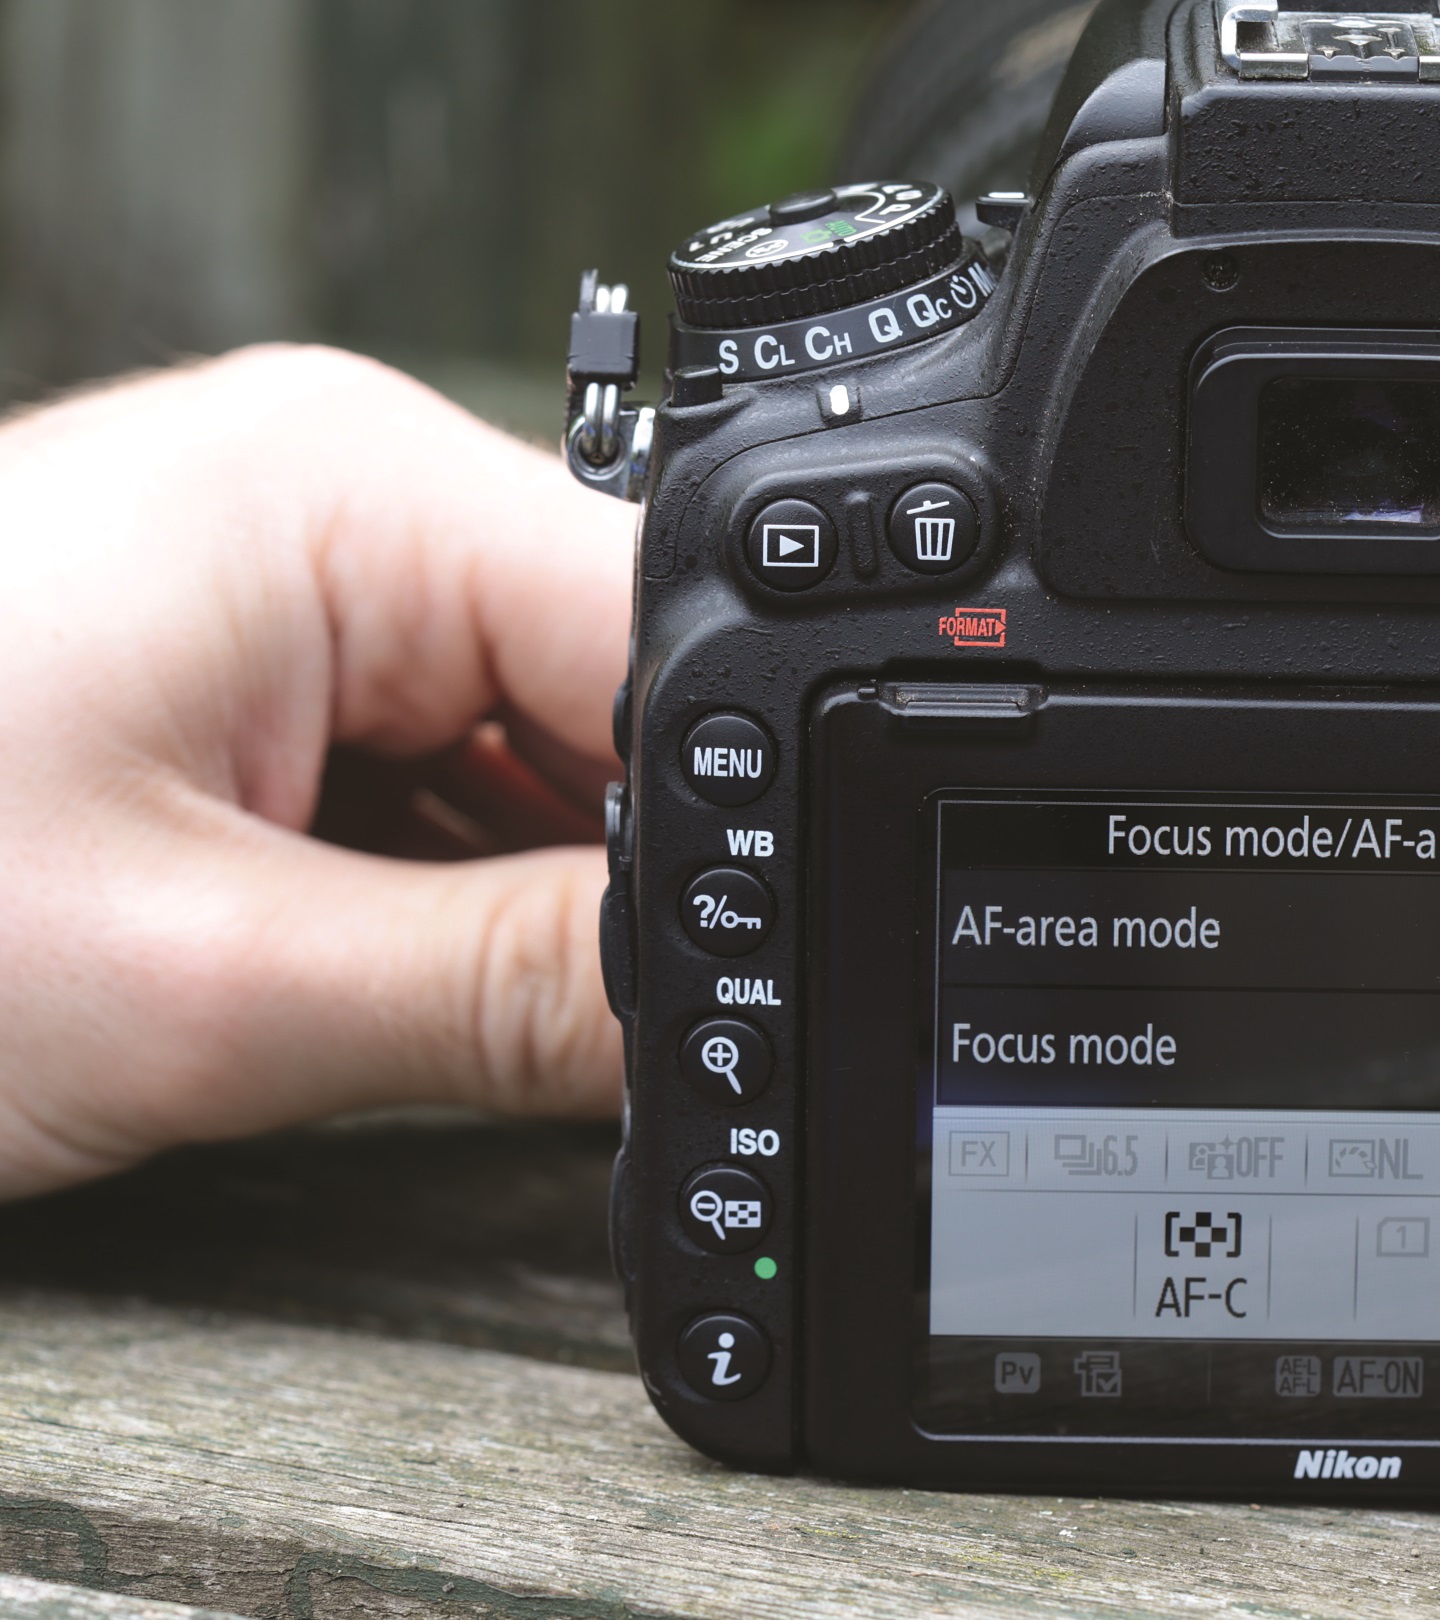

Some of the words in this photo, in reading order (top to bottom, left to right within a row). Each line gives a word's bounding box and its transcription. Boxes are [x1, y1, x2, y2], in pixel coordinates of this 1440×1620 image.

[718, 340, 740, 375] S
[868, 307, 903, 343] Q
[938, 616, 995, 636] FORMAT
[693, 747, 763, 779] MENU
[726, 828, 775, 857] WB
[1108, 815, 1212, 856] Focus
[951, 905, 1098, 947] AF-area
[1113, 906, 1221, 949] mode
[716, 976, 782, 1006] QUAL
[952, 1023, 1056, 1064] Focus
[1069, 1023, 1177, 1066] mode
[730, 1127, 780, 1157] ISO
[960, 1140, 997, 1168] FX
[1102, 1134, 1139, 1177] 6.5
[1235, 1136, 1285, 1179] OFF
[1378, 1137, 1424, 1181] NL
[1154, 1276, 1247, 1319] AF-C
[1000, 1360, 1034, 1385] Pv
[1336, 1359, 1421, 1395] AF-ON
[1293, 1449, 1402, 1479] Nikon
